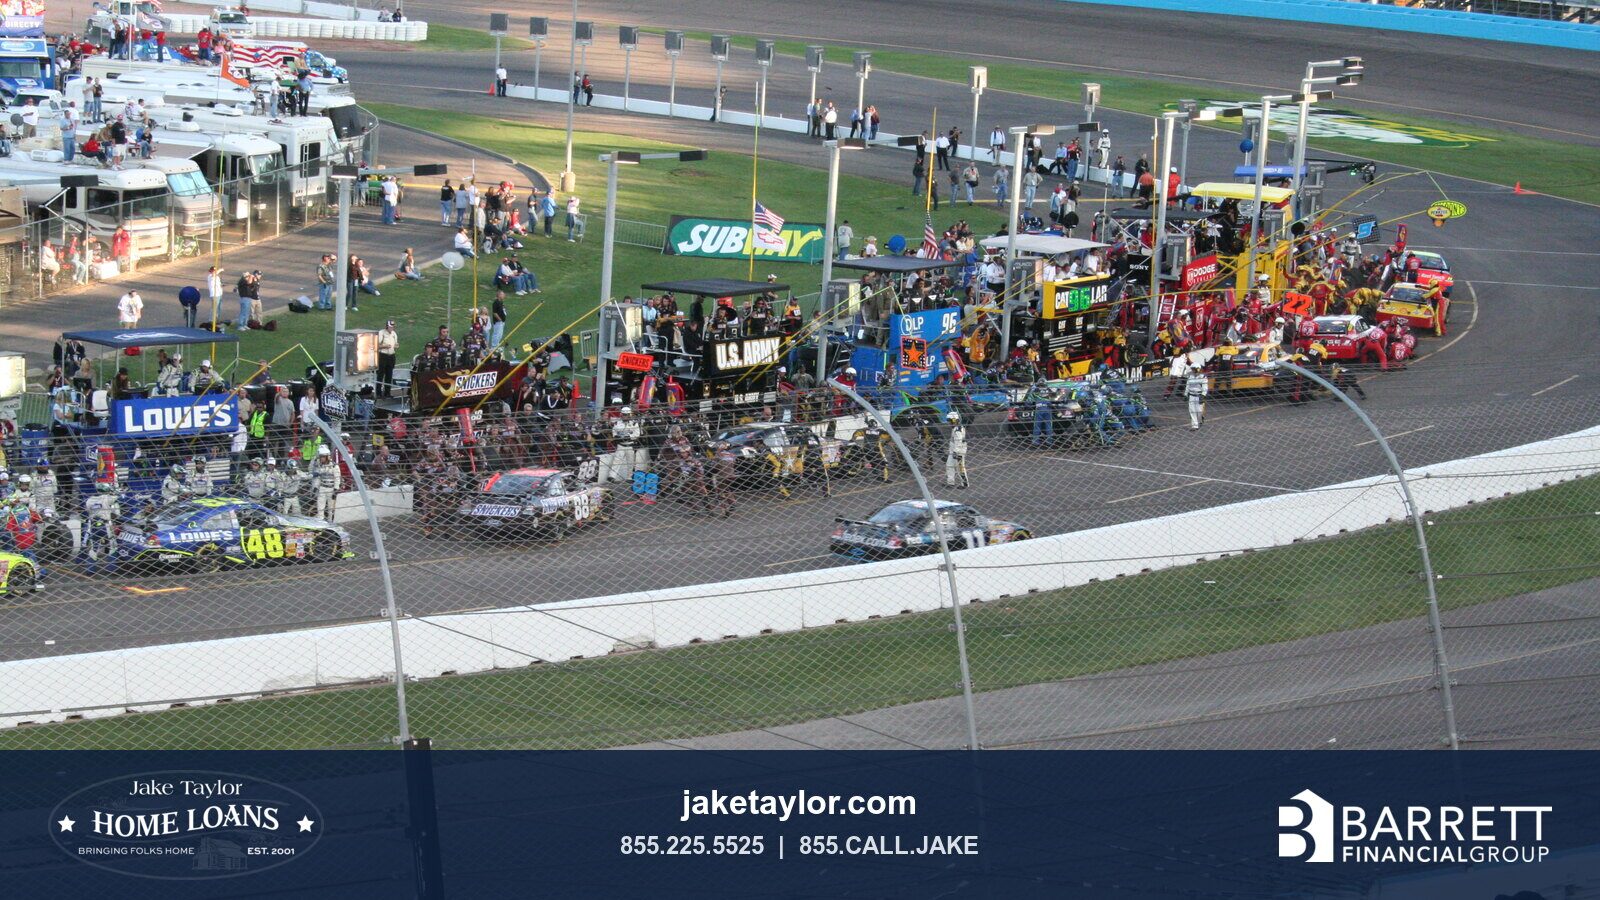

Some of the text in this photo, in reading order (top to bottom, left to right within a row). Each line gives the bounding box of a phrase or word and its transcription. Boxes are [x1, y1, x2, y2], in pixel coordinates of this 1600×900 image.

[5, 20, 40, 28] DIRECTV
[1193, 263, 1216, 278] DODGE
[1282, 292, 1312, 316] 22
[942, 312, 958, 335] 96
[621, 355, 650, 370] SNICKERS
[715, 336, 780, 370] U.S. ARMY
[456, 372, 496, 392] SNICKERS
[124, 400, 232, 432] LOWE'S
[472, 504, 521, 517] SNICKERS
[169, 530, 233, 544] LOWE'S
[247, 527, 285, 559] 48
[962, 530, 985, 549] 11
